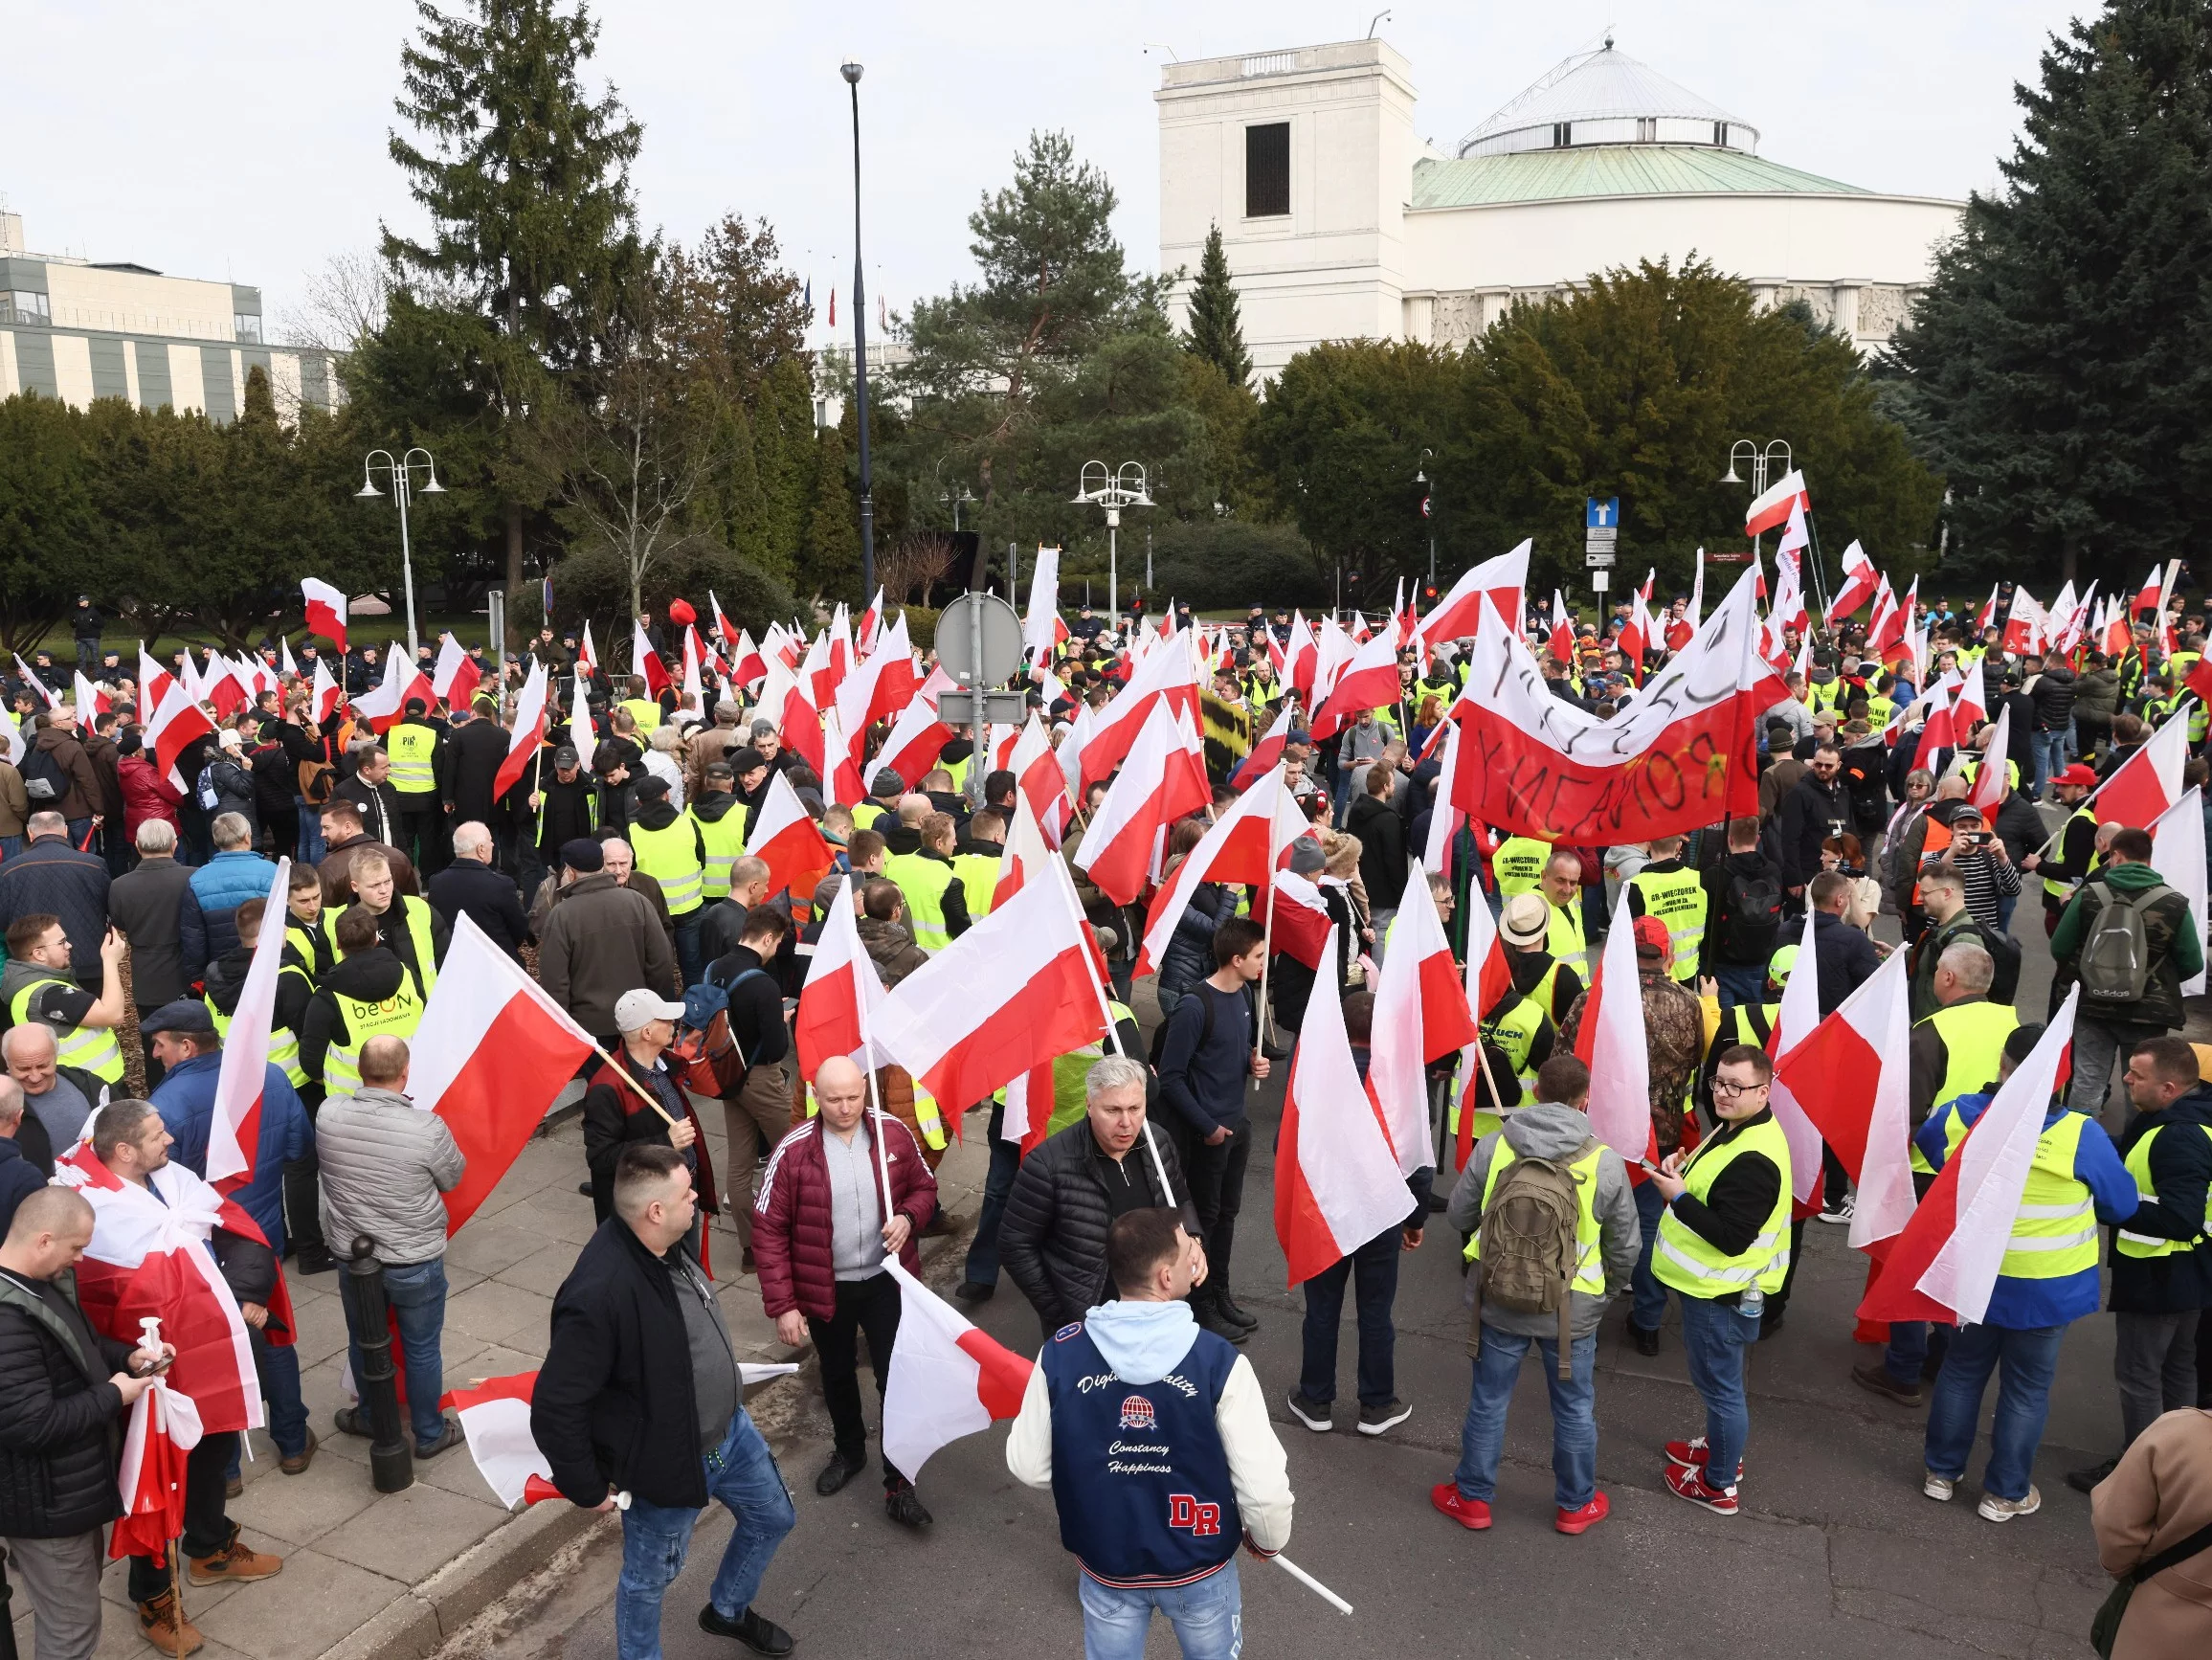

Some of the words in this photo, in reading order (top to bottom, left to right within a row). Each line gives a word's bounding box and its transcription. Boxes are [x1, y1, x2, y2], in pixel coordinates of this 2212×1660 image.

[1867, 707, 1887, 718] OLNIK
[1651, 886, 1697, 902] GR-WIECZOREK
[2092, 989, 2130, 998] adidas
[1161, 1375, 1199, 1398] ality
[1108, 1440, 1171, 1457] Constancy
[1107, 1460, 1172, 1474] Happiness
[1169, 1493, 1220, 1537] DR
